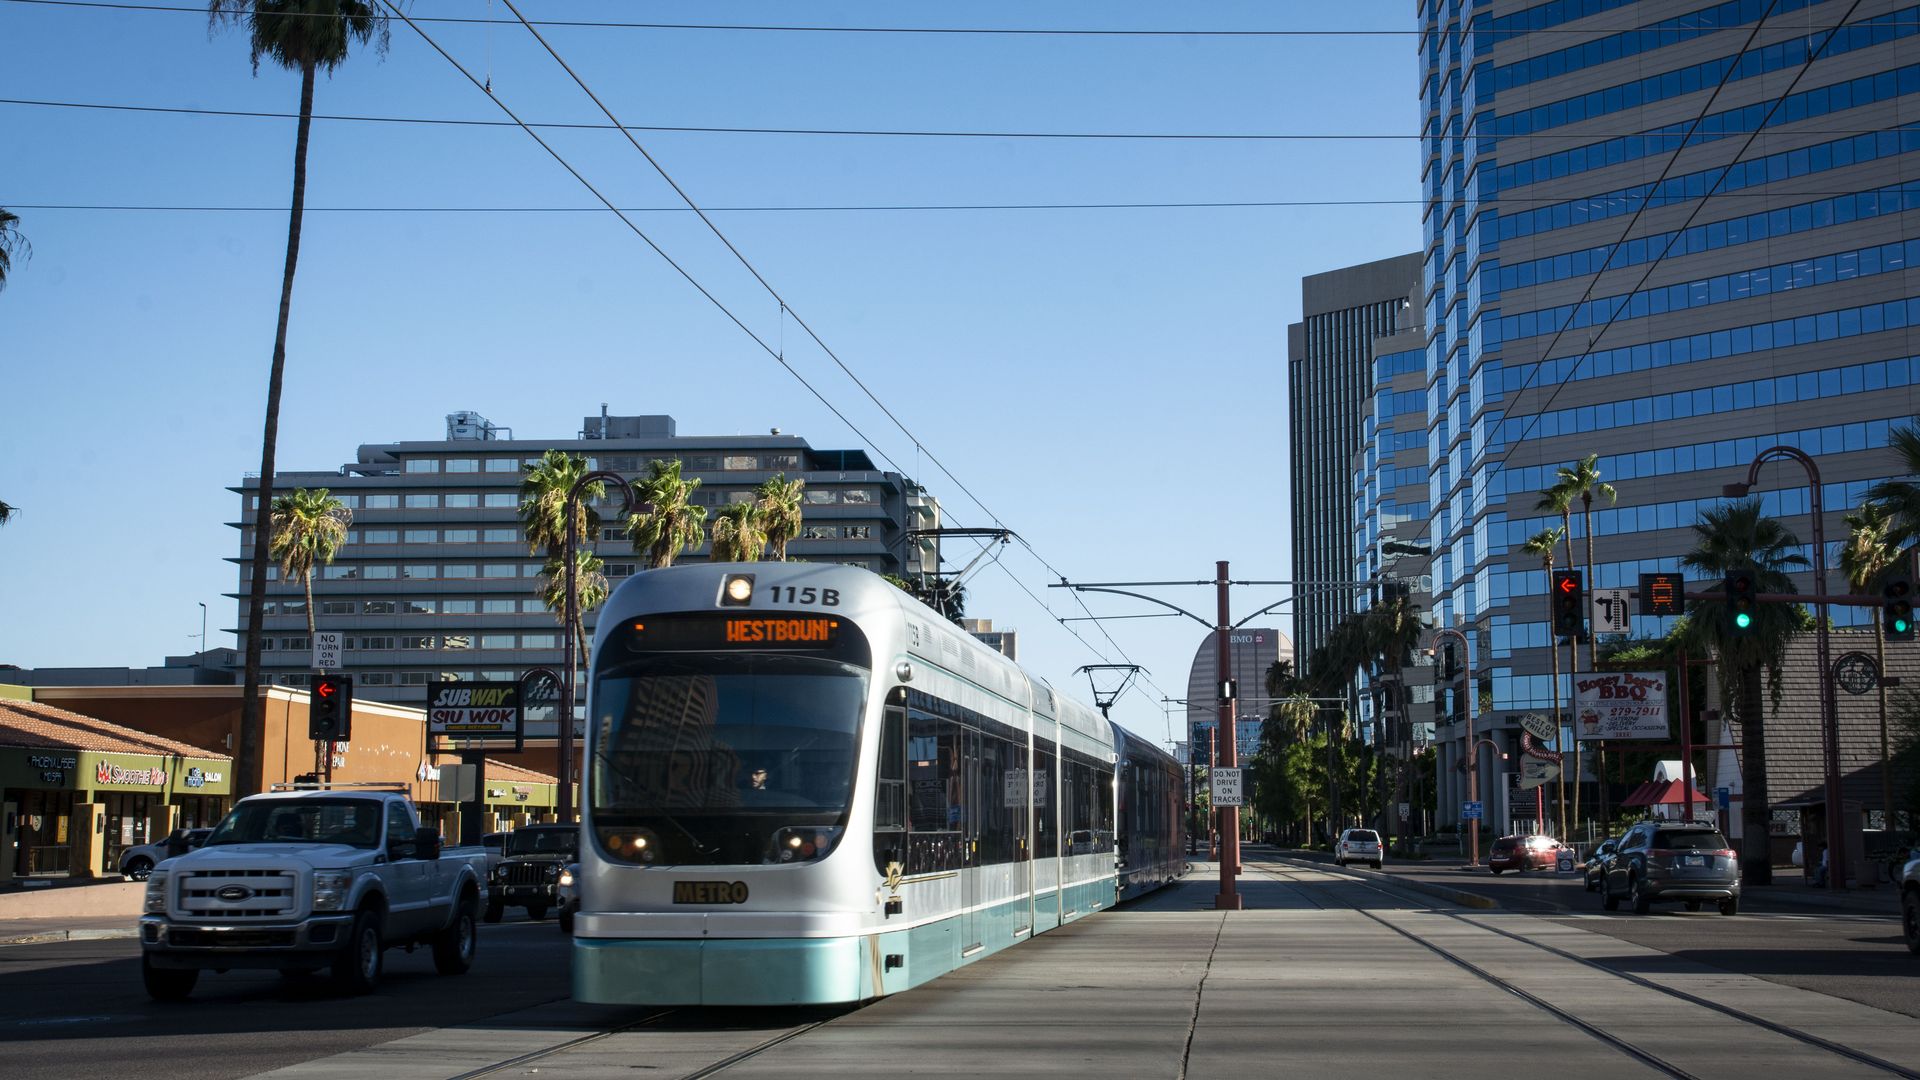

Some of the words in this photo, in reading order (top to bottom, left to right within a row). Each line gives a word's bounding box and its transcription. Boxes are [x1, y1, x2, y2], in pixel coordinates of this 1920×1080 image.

[770, 585, 840, 606] 115B
[321, 634, 336, 642] NO
[727, 619, 829, 641] WESTBOUN
[1230, 635, 1253, 643] BMO
[1577, 676, 1620, 693] Honey
[1624, 673, 1664, 691] Bear's
[433, 687, 514, 707] SUBWAY
[1599, 685, 1648, 701] BBQ
[432, 709, 464, 724] SIU
[469, 709, 515, 723] WOK
[1610, 706, 1661, 716] 279-7911
[1524, 720, 1551, 738] PHILLY
[1526, 713, 1545, 726] BEST
[1545, 724, 1556, 732] OF
[31, 755, 56, 768] PHOENIX
[57, 756, 76, 769] LASER
[204, 772, 222, 782] SALON
[674, 882, 748, 904] METRO
